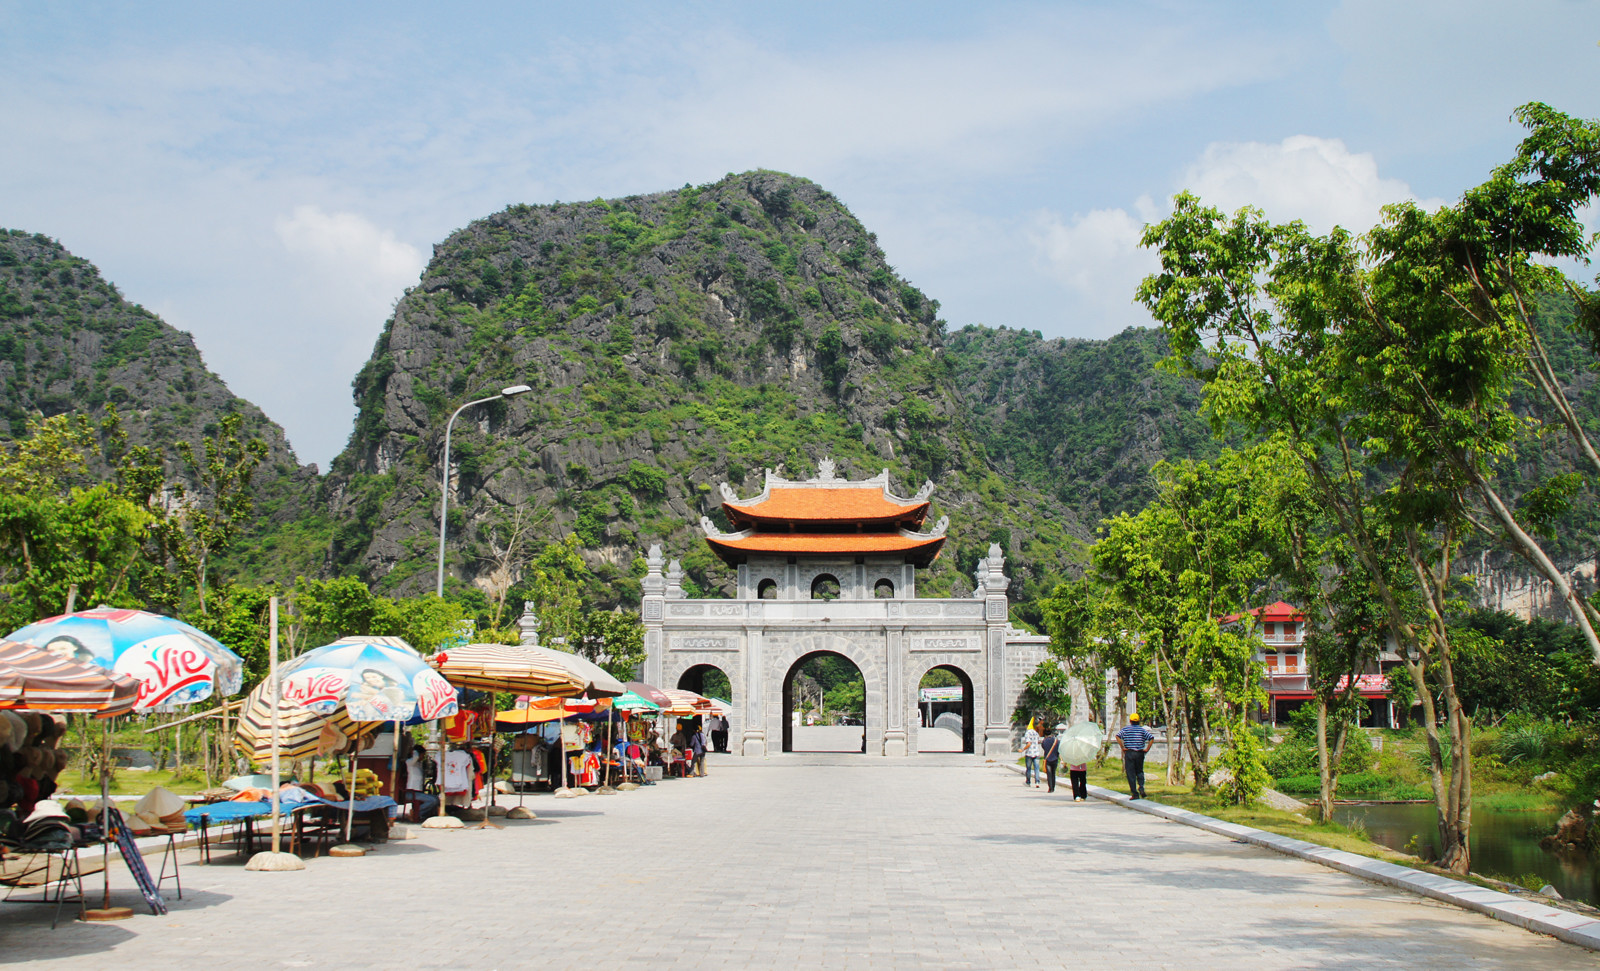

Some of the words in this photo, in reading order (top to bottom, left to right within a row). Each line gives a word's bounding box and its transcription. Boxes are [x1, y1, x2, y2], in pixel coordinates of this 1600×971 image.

[145, 647, 210, 688] Vie
[285, 681, 305, 700] La
[307, 674, 345, 700] Vie
[420, 694, 434, 718] La
[428, 678, 455, 701] Vie
